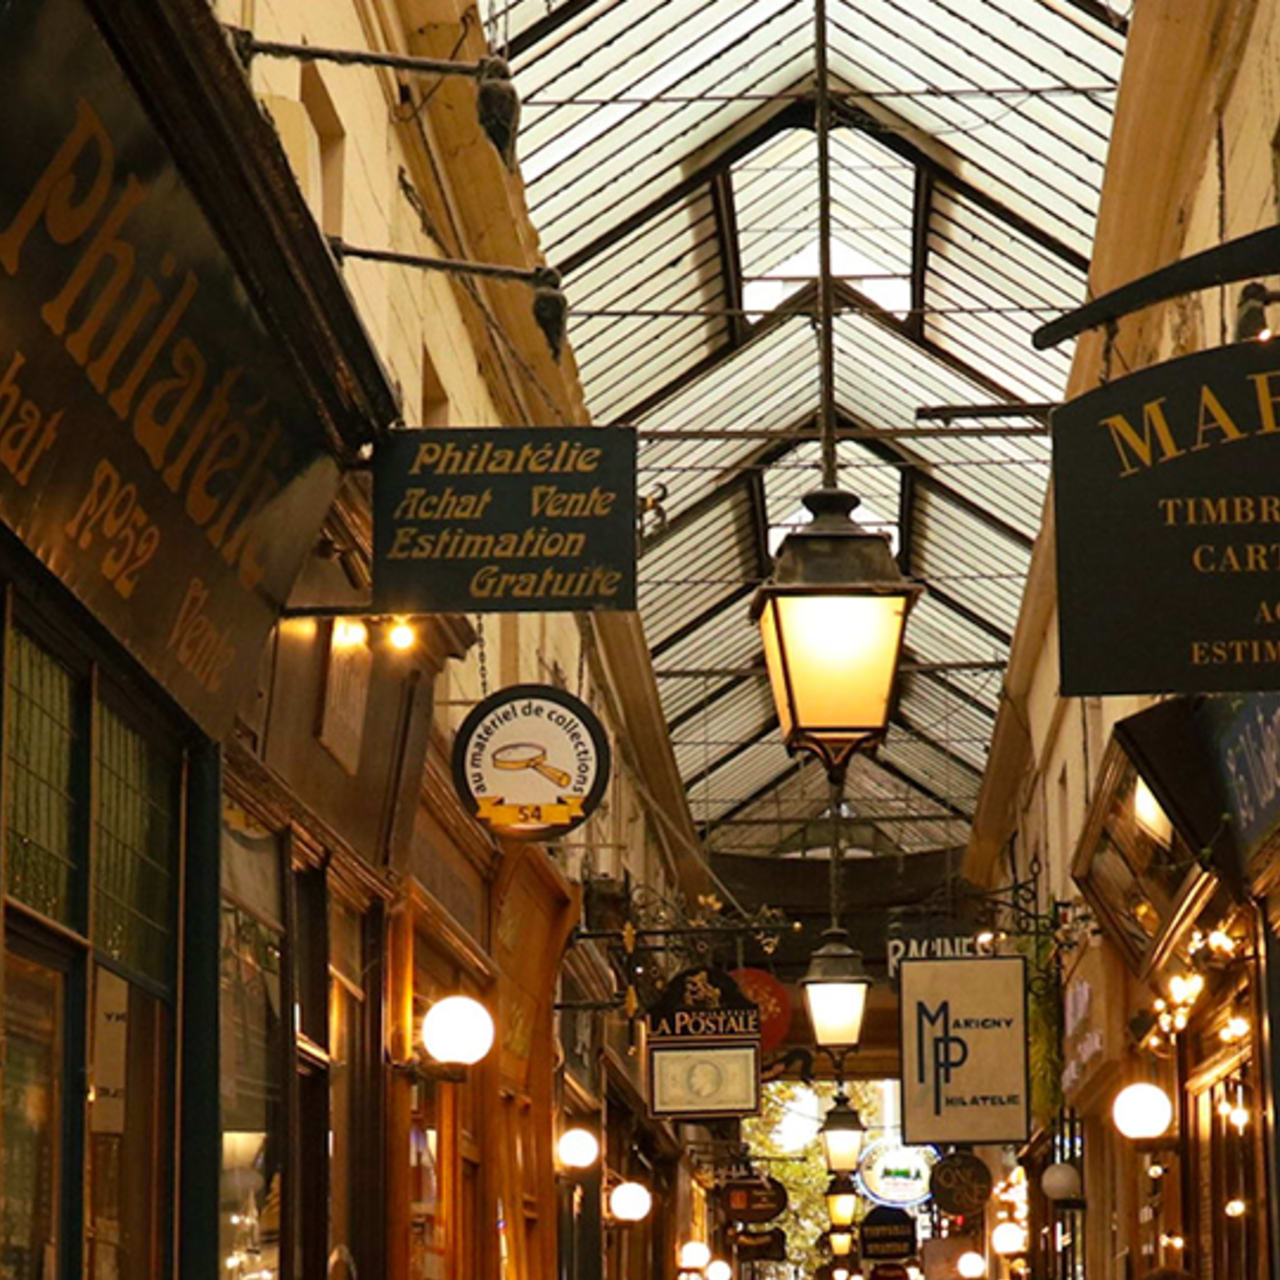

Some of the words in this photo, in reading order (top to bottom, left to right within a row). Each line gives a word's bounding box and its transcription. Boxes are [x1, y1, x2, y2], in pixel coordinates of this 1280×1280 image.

[408, 441, 602, 475] Philatélie
[393, 486, 493, 520] Achat
[530, 485, 617, 518] Vente
[386, 526, 587, 559] Estimation
[470, 564, 623, 597] Gratuite
[471, 772, 487, 793] au
[521, 701, 544, 717] de
[518, 806, 542, 822] 54
[645, 1013, 672, 1035] LA
[674, 1011, 759, 1035] POSTALE
